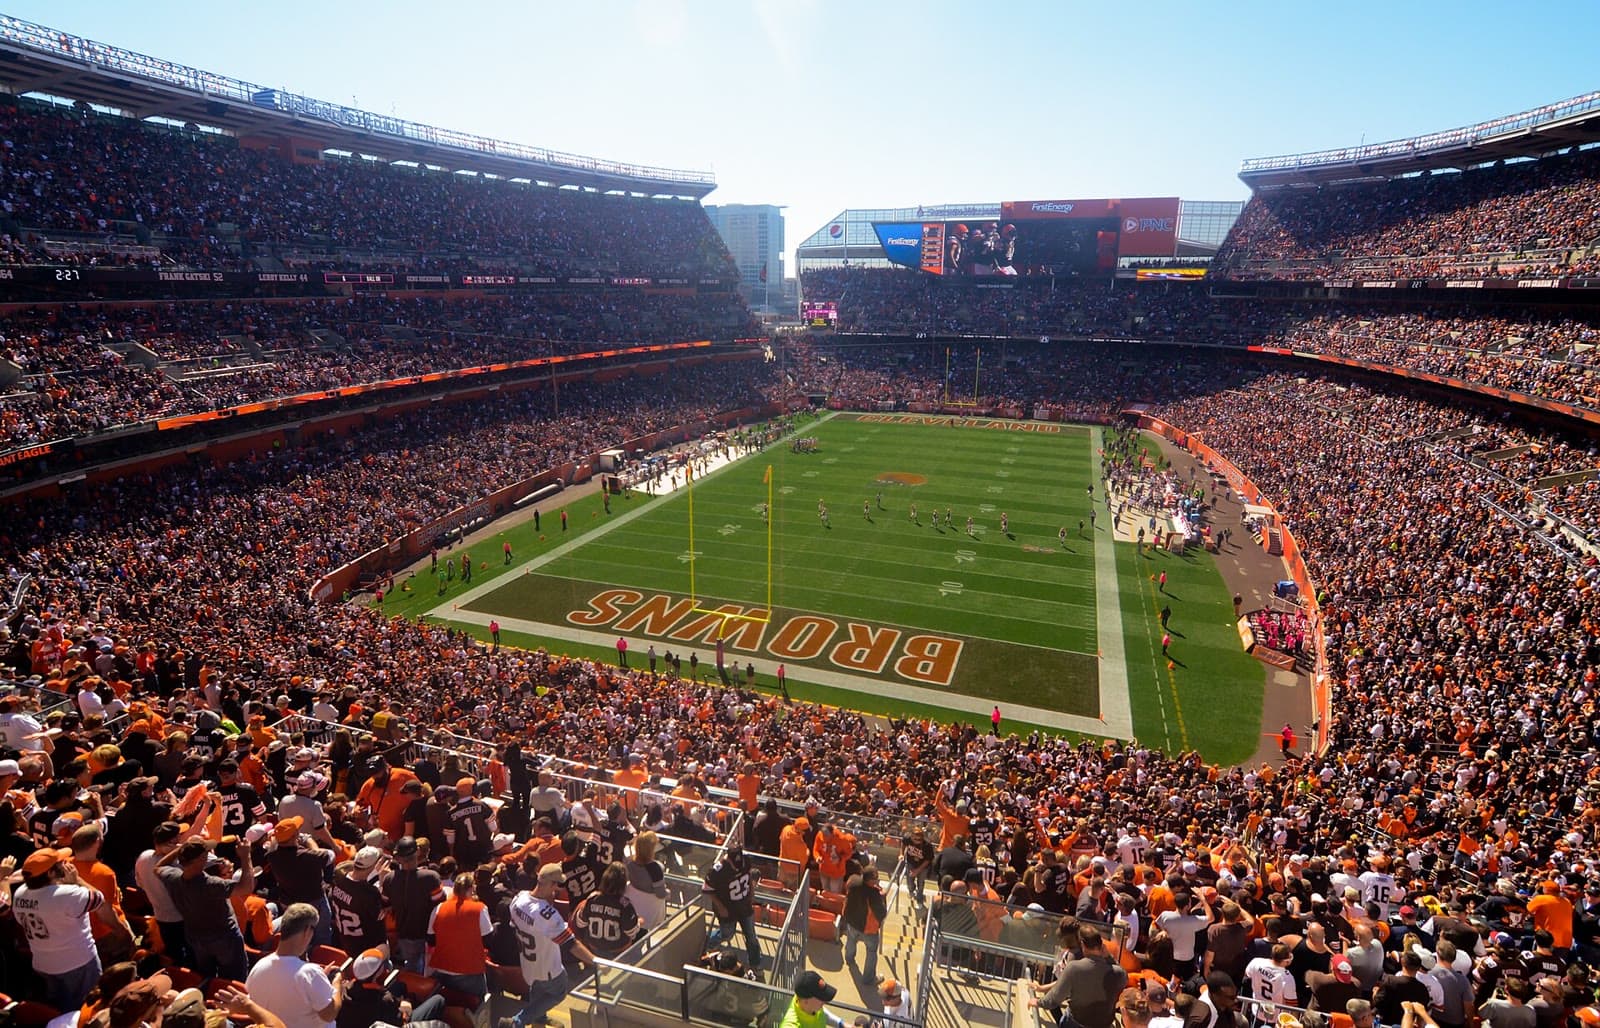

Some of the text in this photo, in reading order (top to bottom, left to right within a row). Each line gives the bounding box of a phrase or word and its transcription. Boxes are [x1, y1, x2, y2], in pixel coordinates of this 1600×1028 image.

[1031, 202, 1074, 213] FirstEnergy
[1140, 218, 1173, 232] PNC
[887, 237, 919, 247] FirstEnergy
[55, 269, 80, 281] 2:27
[158, 272, 184, 281] FRANK
[213, 273, 224, 282] 52
[856, 414, 1061, 433] CLEVELAND
[17, 444, 52, 461] EAGLE
[938, 581, 964, 596] 10
[566, 588, 965, 687] BROWNS
[463, 817, 477, 841] 1
[975, 832, 993, 846] 23
[332, 886, 353, 906] BROWN
[728, 873, 750, 901] 23
[1372, 884, 1391, 904] 16
[15, 897, 39, 910] KOSAR
[332, 900, 364, 937] 12
[588, 916, 622, 942] 00
[1261, 979, 1273, 1001] 2
